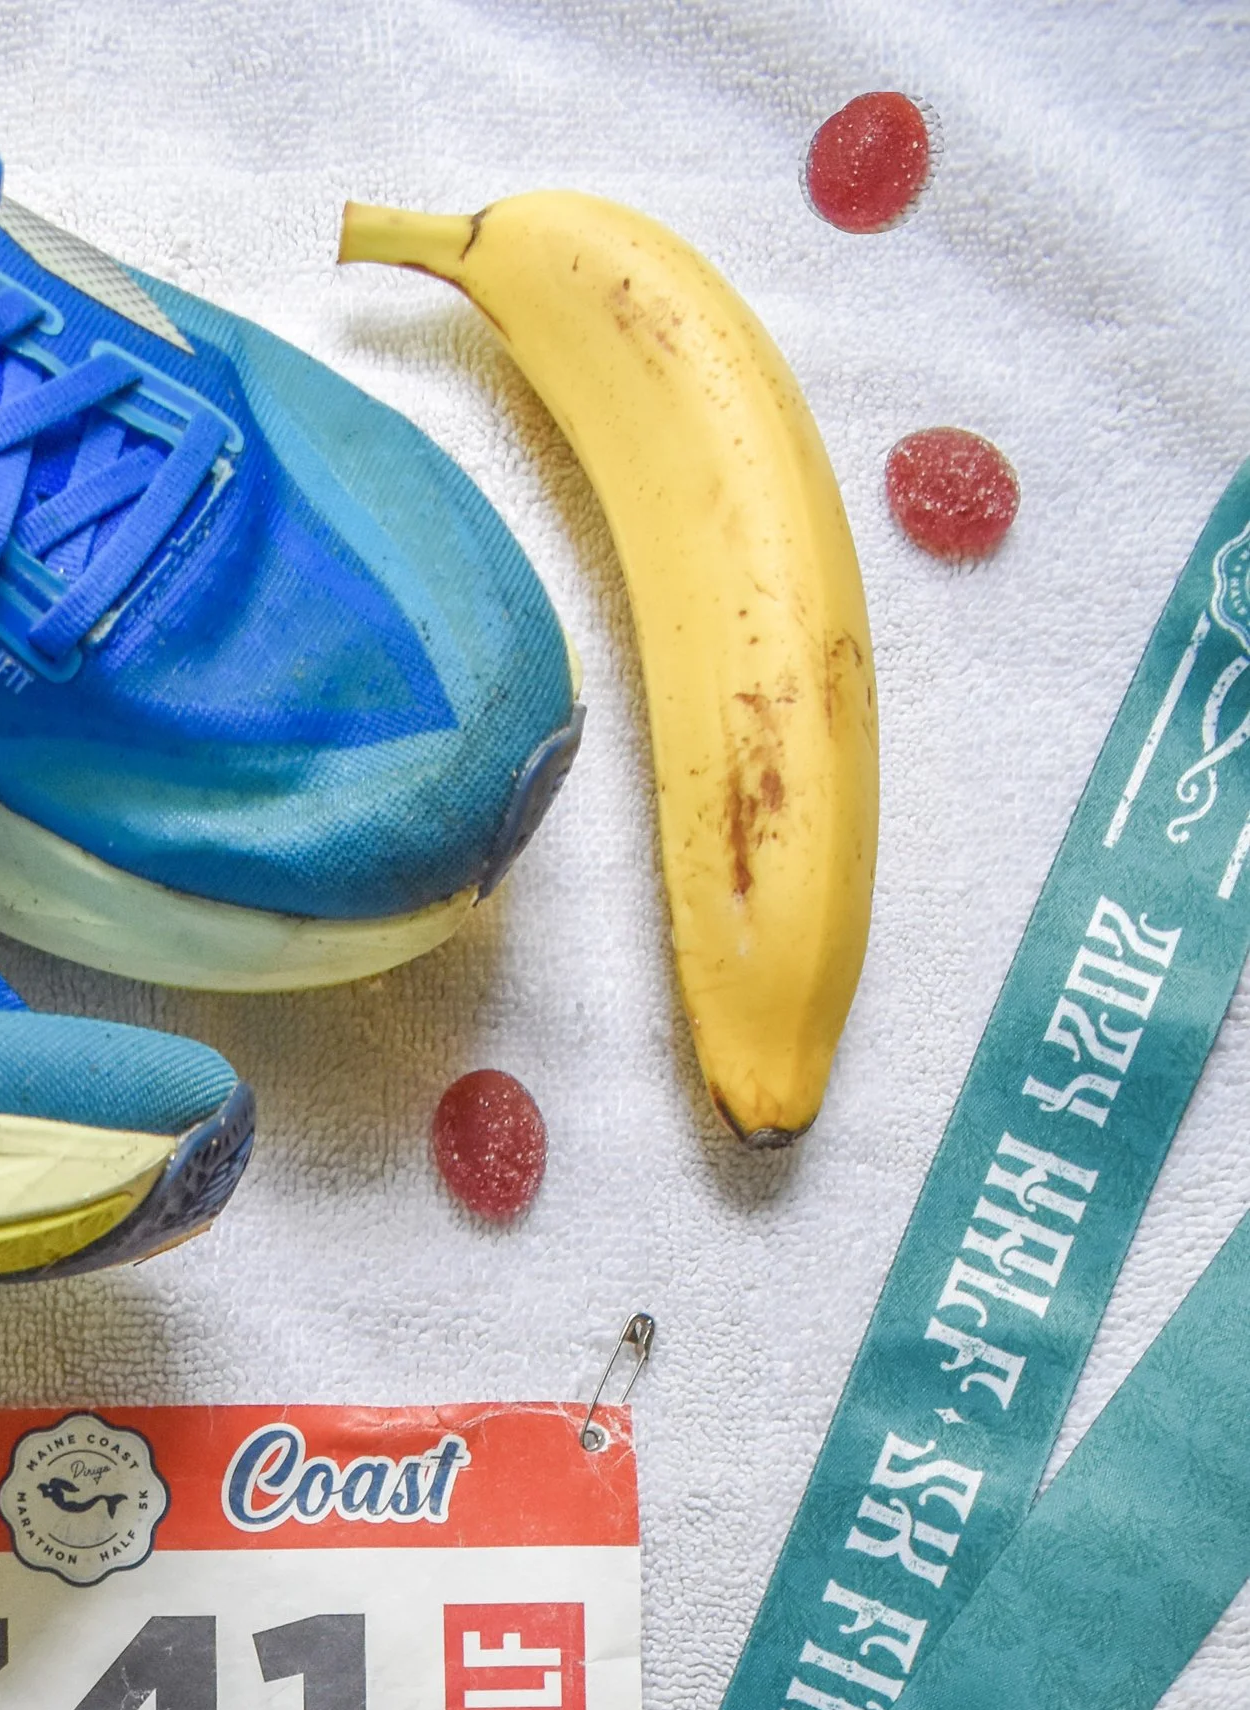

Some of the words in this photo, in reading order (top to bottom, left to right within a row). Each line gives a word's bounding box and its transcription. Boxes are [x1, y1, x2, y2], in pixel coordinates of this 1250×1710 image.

[1021, 895, 1183, 1128] 2024
[923, 1131, 1099, 1410] HALF
[26, 1433, 76, 1472] MAINE
[86, 1433, 139, 1470] COAST
[224, 1425, 468, 1529] Coast
[844, 1431, 984, 1589] 5K
[17, 1491, 78, 1565] MARATHON
[99, 1529, 136, 1562] HALF
[138, 1489, 149, 1510] 5K
